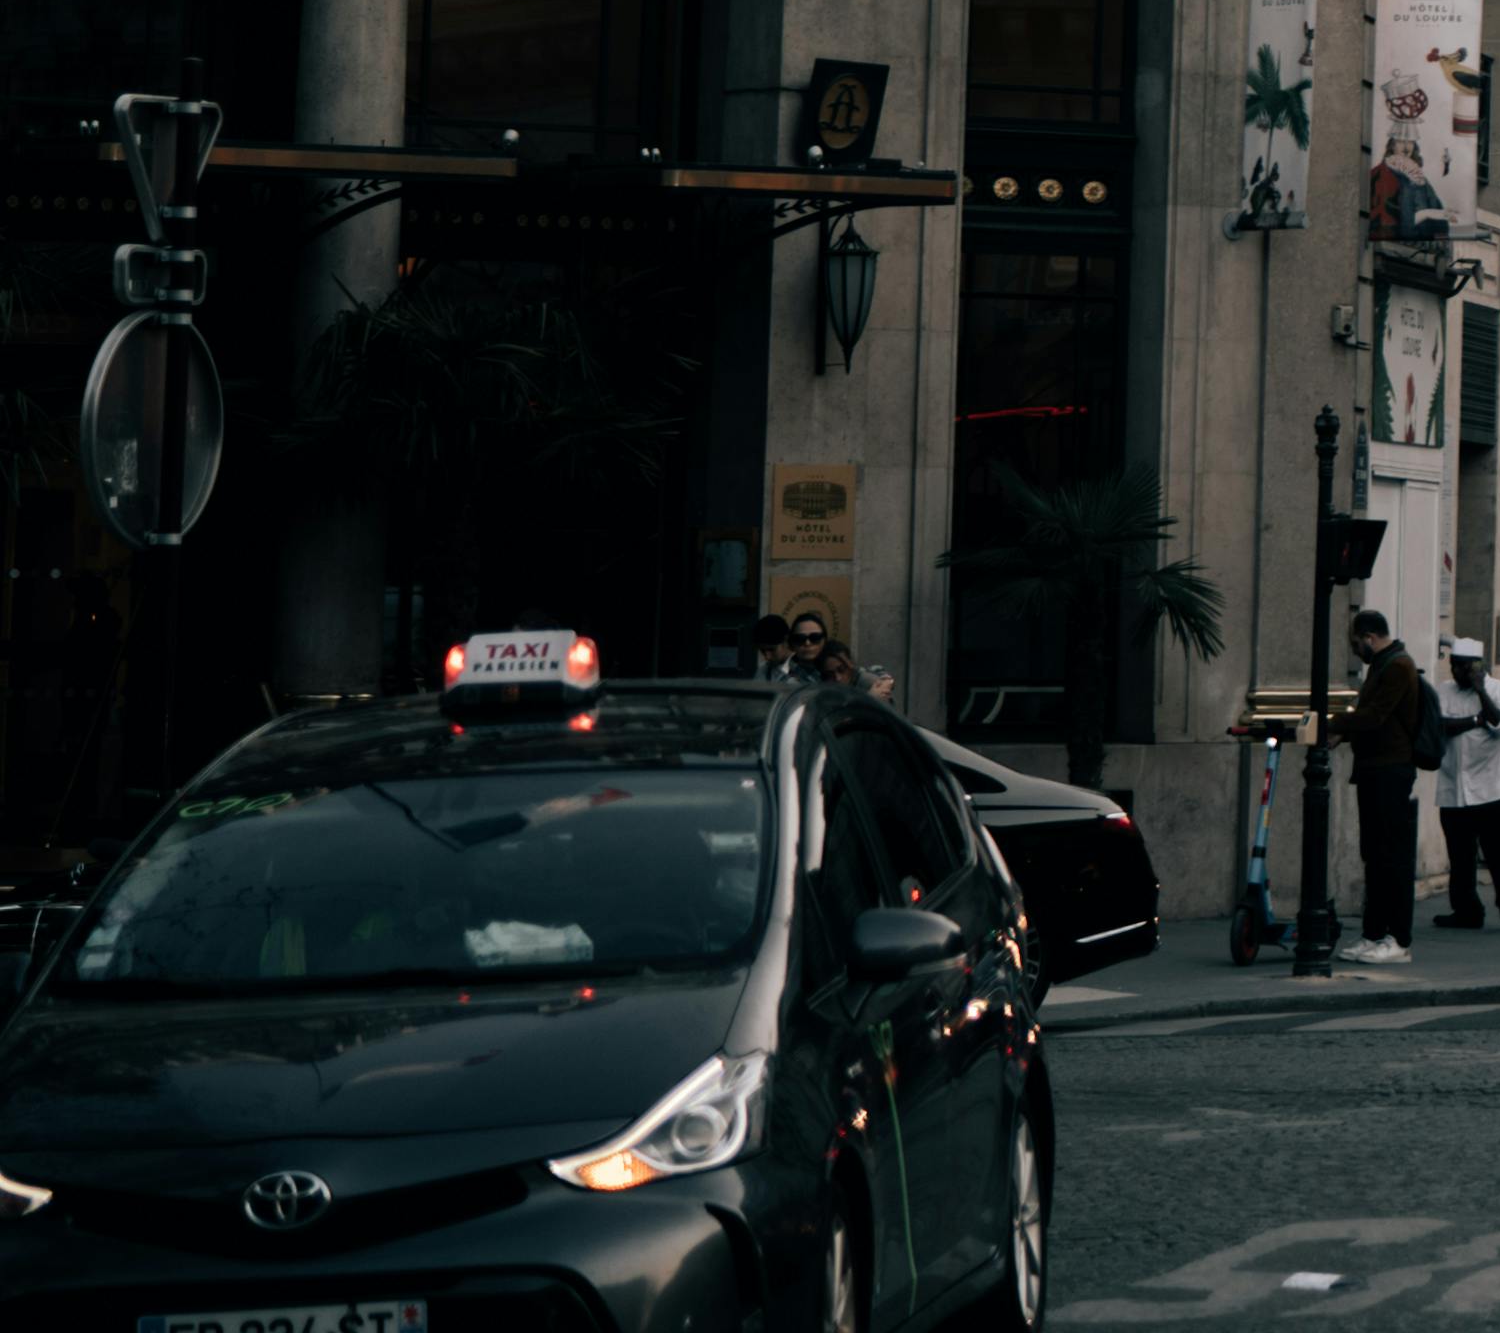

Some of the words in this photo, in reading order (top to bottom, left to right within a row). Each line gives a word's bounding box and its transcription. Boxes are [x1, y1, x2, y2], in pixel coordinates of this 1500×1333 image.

[1409, 2, 1449, 13] HÔTEL
[1393, 14, 1410, 23] DU
[1415, 13, 1463, 23] LOUVRE
[796, 523, 832, 533] HÔTEL
[781, 535, 797, 543] DU
[801, 534, 845, 544] LOUVRE
[485, 642, 550, 660] TAXI
[472, 660, 560, 673] PARISIEN
